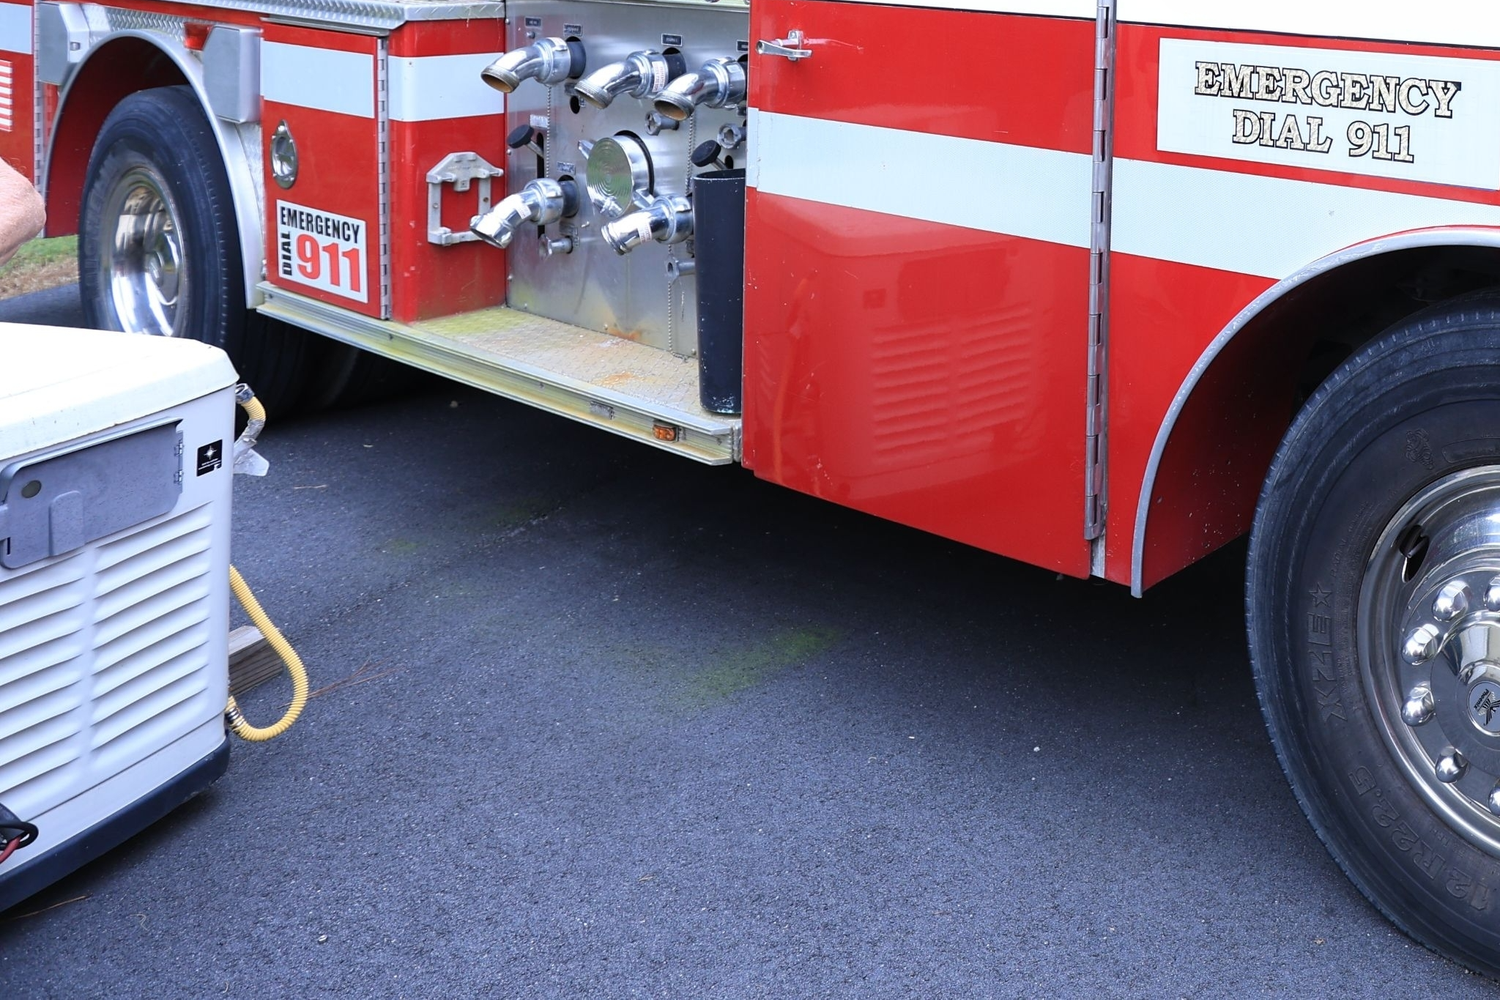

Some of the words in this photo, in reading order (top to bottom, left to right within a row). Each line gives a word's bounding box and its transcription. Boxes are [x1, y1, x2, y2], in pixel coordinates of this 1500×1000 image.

[1194, 61, 1462, 119] EMERGENCY
[1232, 109, 1333, 154] DIAL
[1346, 120, 1415, 164] 911
[280, 206, 360, 244] EMERGENCY
[281, 231, 293, 276] DIAL
[296, 233, 361, 293] 911
[1307, 611, 1349, 723] XZE
